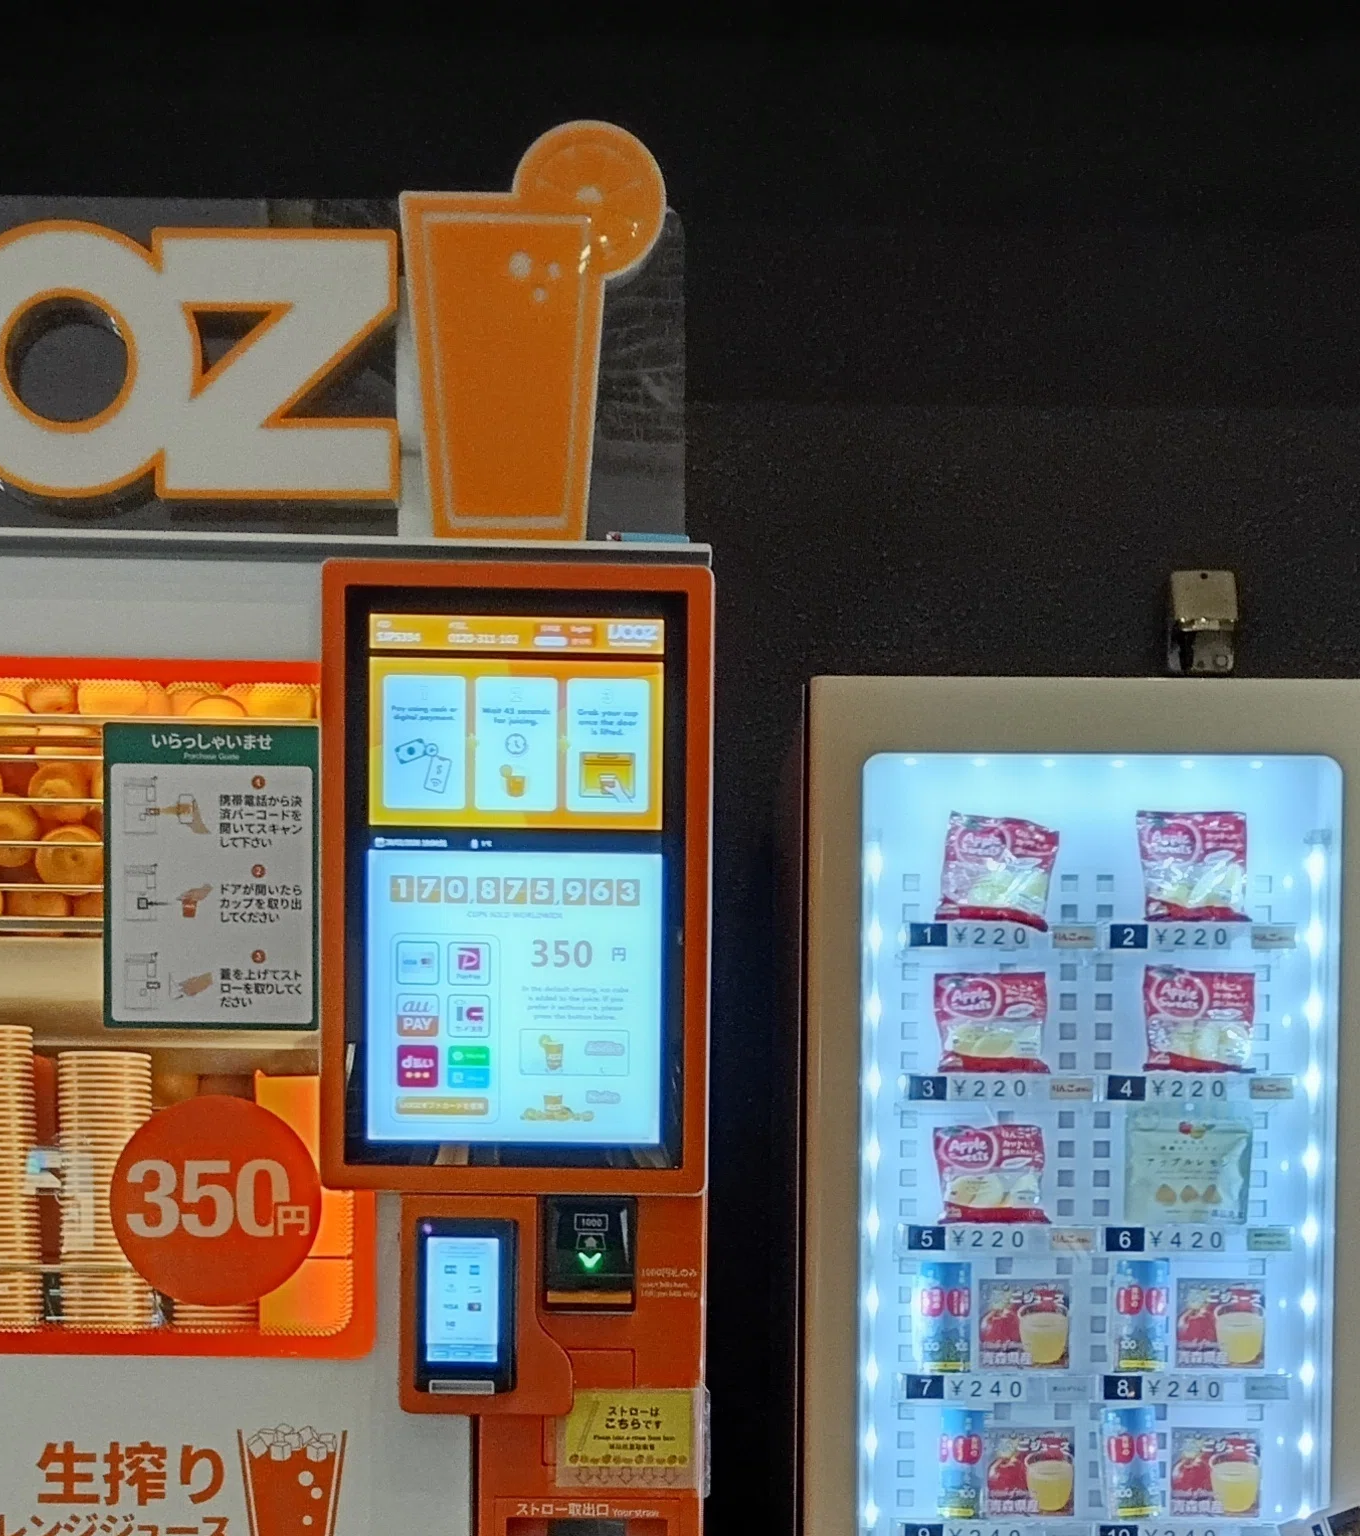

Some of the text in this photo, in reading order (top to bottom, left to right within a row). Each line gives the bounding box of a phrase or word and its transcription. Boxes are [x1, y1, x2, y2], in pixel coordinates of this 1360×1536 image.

[151, 733, 273, 750] いらっしゃいませ
[219, 795, 303, 808] 携帯電話から決
[219, 809, 302, 821] 済バーコードを
[219, 823, 303, 835] 開いてスキャン
[219, 837, 272, 848] して下さい
[220, 884, 302, 896] ドアが開いたら
[219, 899, 302, 910] カップを取り出
[219, 912, 280, 923] してください
[922, 928, 932, 943] 1
[1123, 928, 1135, 946] 2
[531, 939, 593, 968] 350
[611, 948, 626, 962] 円
[219, 969, 302, 981] 蓋を上げてスト
[220, 997, 253, 1008] ださい
[403, 1001, 433, 1013] au
[403, 1018, 433, 1030] PAY
[922, 1080, 934, 1098] 3
[1120, 1080, 1133, 1097] 4
[948, 1137, 988, 1156] Apple
[126, 1158, 310, 1238] 350円
[921, 1230, 933, 1248] 5
[1119, 1231, 1132, 1249] 6
[920, 1379, 932, 1395] 7
[1116, 1379, 1129, 1397] 8
[608, 1405, 660, 1417] ストローは
[605, 1418, 662, 1430] こちらです
[36, 1439, 225, 1508] 生搾り
[516, 1503, 609, 1517] ストロー取出口
